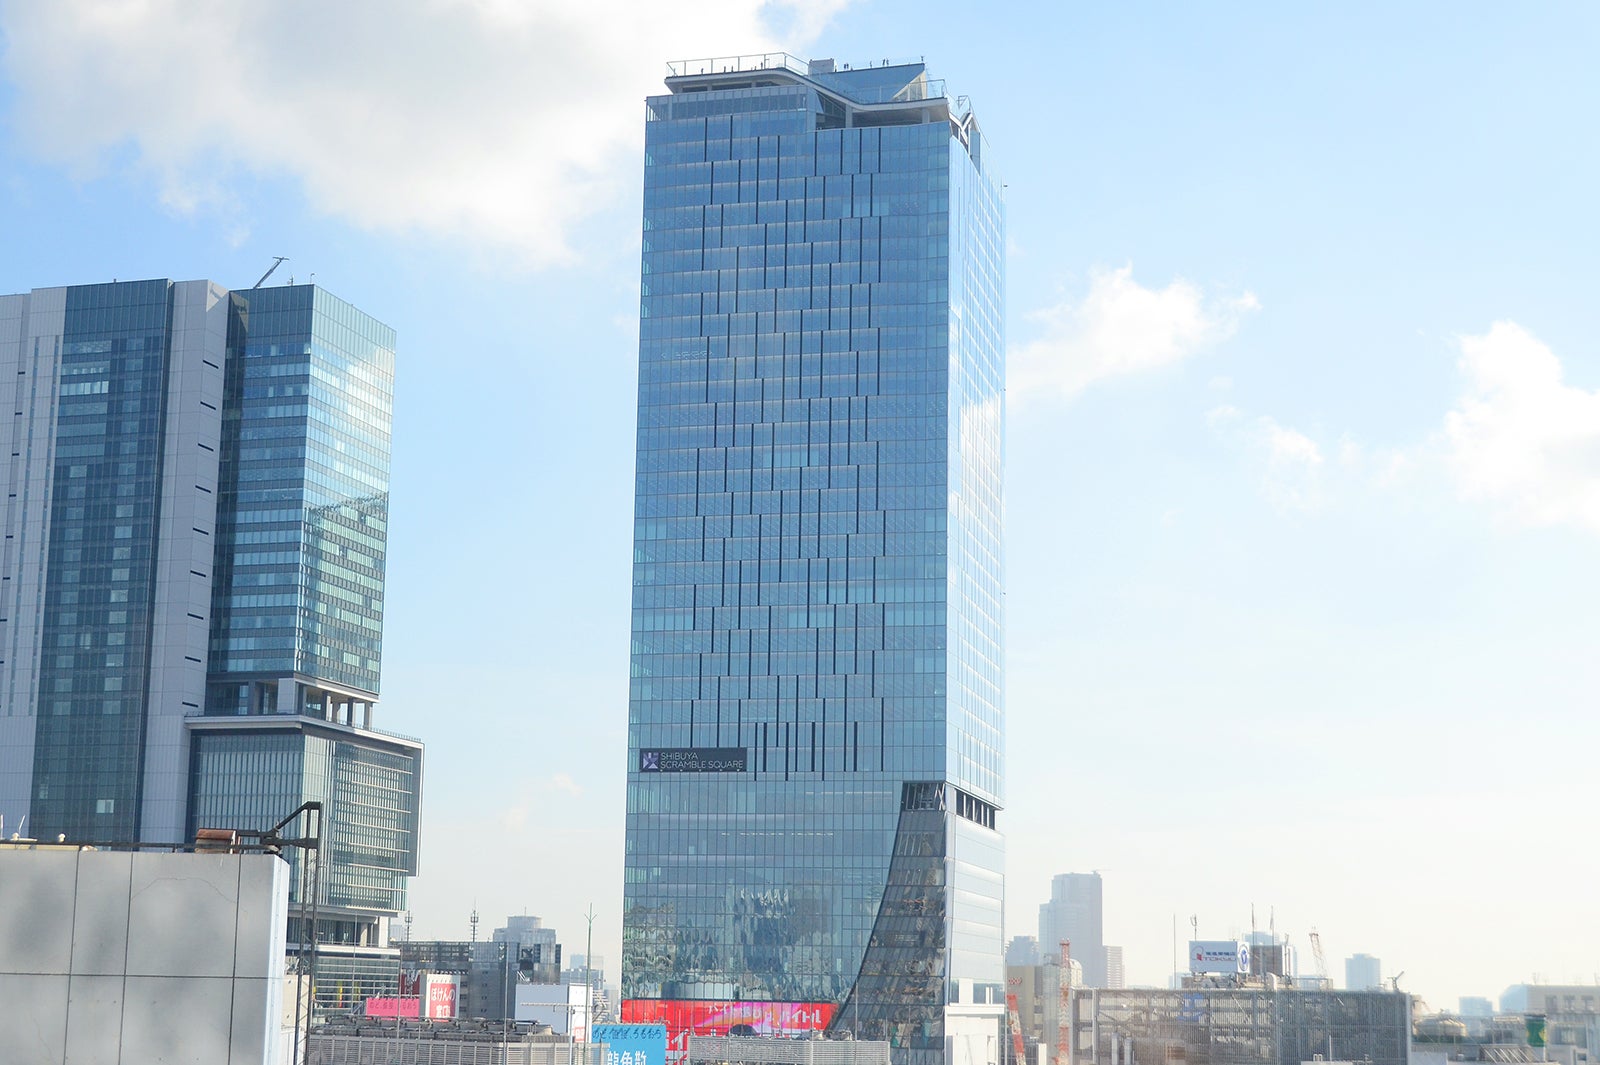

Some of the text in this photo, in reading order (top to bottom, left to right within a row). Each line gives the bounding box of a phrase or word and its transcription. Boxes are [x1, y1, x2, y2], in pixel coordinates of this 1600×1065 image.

[661, 752, 698, 760] SHIBUYA
[660, 760, 744, 769] SCRAMBLE SQUARE
[431, 987, 455, 1002] ほけんの
